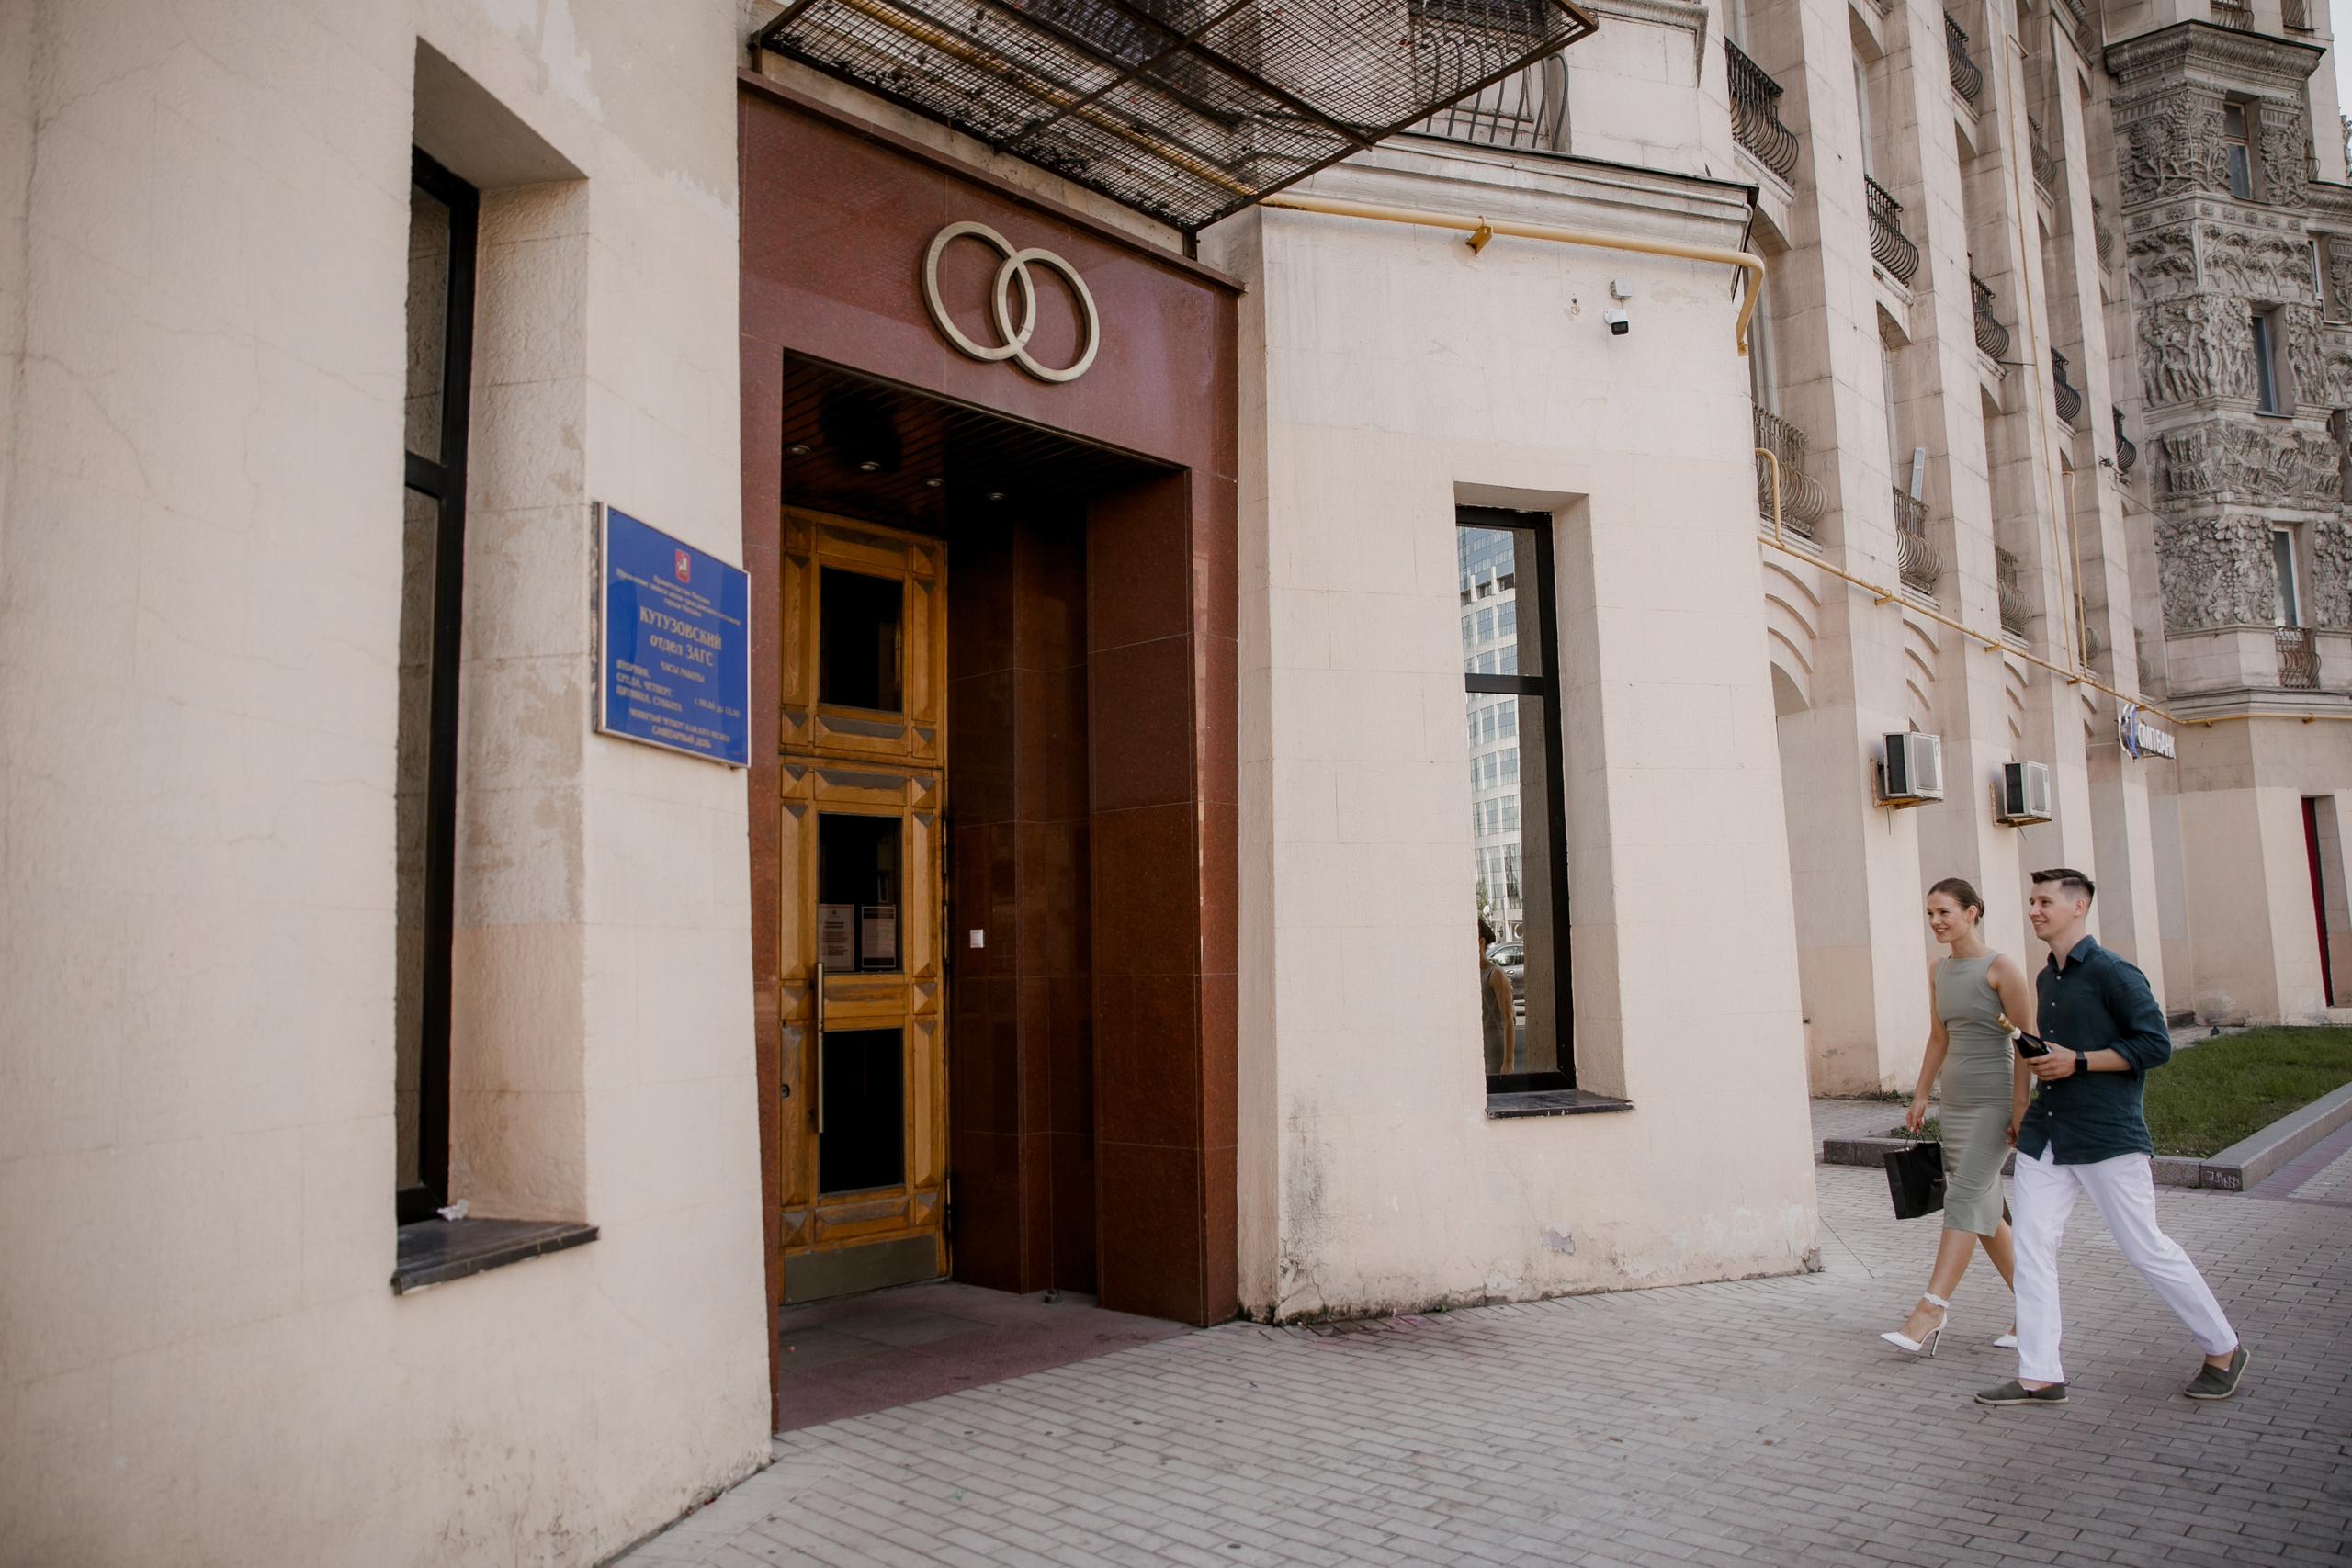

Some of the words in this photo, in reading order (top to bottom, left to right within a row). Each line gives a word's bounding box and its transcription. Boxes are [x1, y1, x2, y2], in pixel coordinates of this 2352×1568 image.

[639, 605, 722, 651] КУТУЗОВСКИЙ
[650, 634, 684, 656] отдел
[685, 644, 714, 668] ЗАГС
